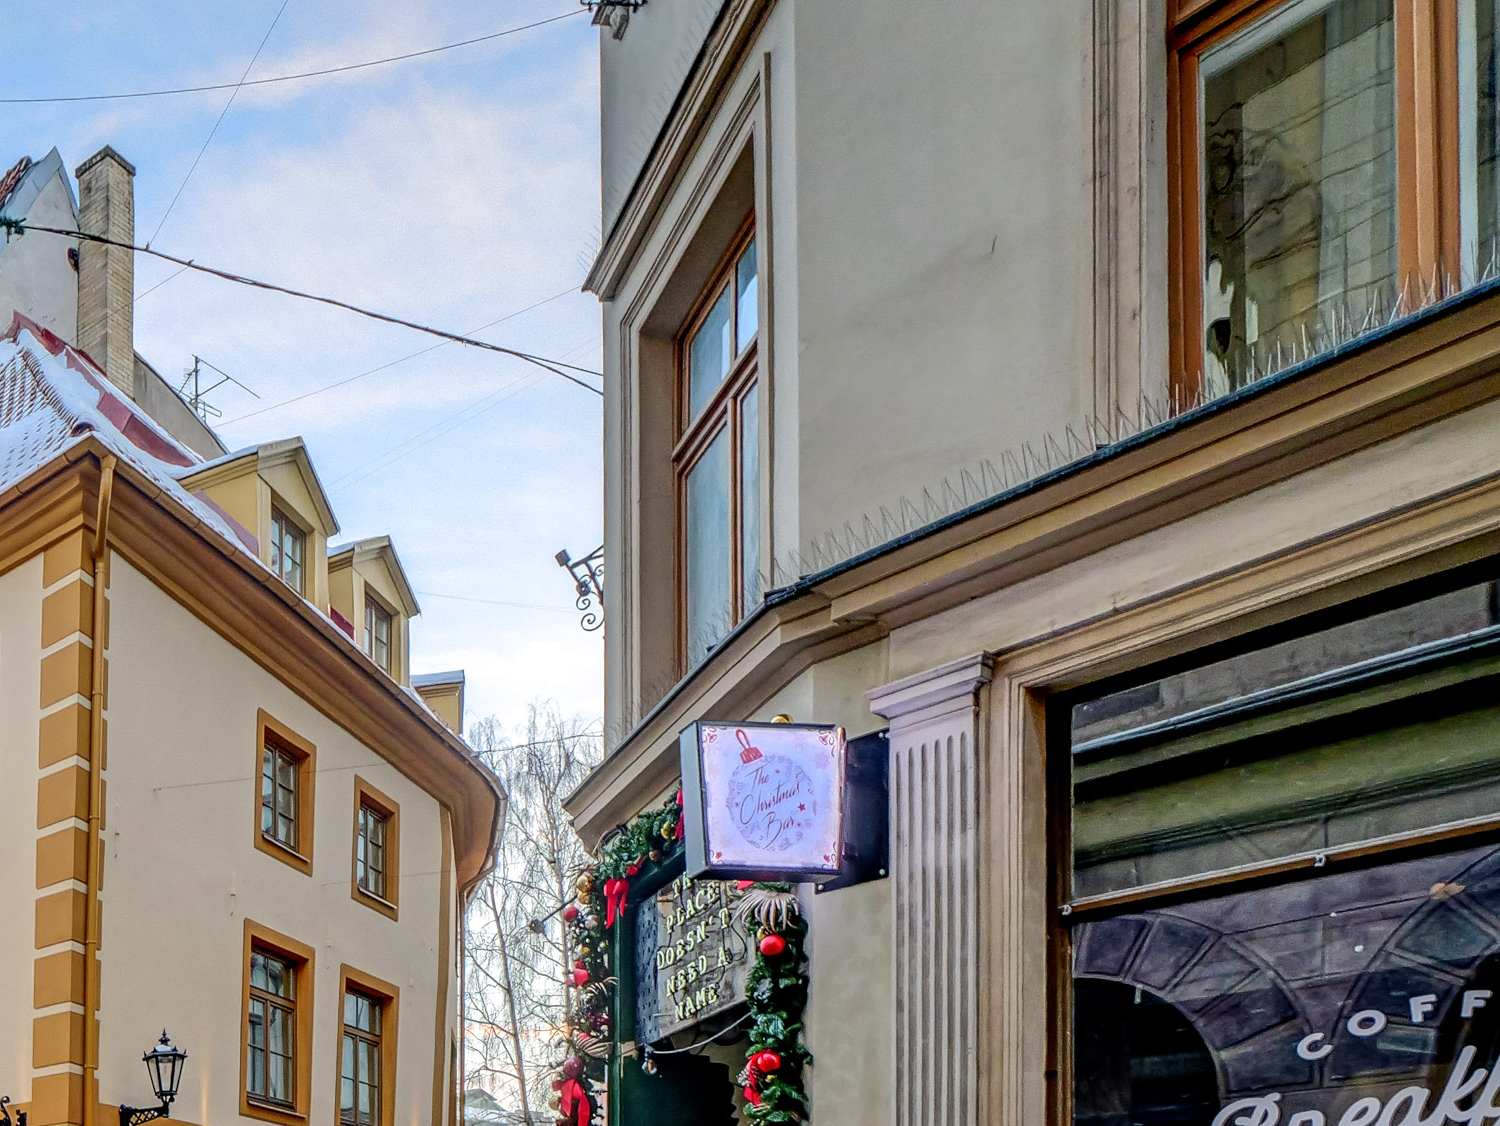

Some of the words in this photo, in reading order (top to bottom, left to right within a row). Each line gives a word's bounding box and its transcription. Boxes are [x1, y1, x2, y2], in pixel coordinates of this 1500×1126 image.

[745, 760, 772, 792] The
[740, 780, 800, 825] Christmas
[762, 811, 795, 850] Bar
[671, 871, 693, 898] TH
[666, 881, 721, 934] PLACE
[656, 907, 730, 970] DOESN'T
[666, 955, 708, 997] NEED
[717, 947, 729, 967] A
[674, 983, 719, 1023] NAME
